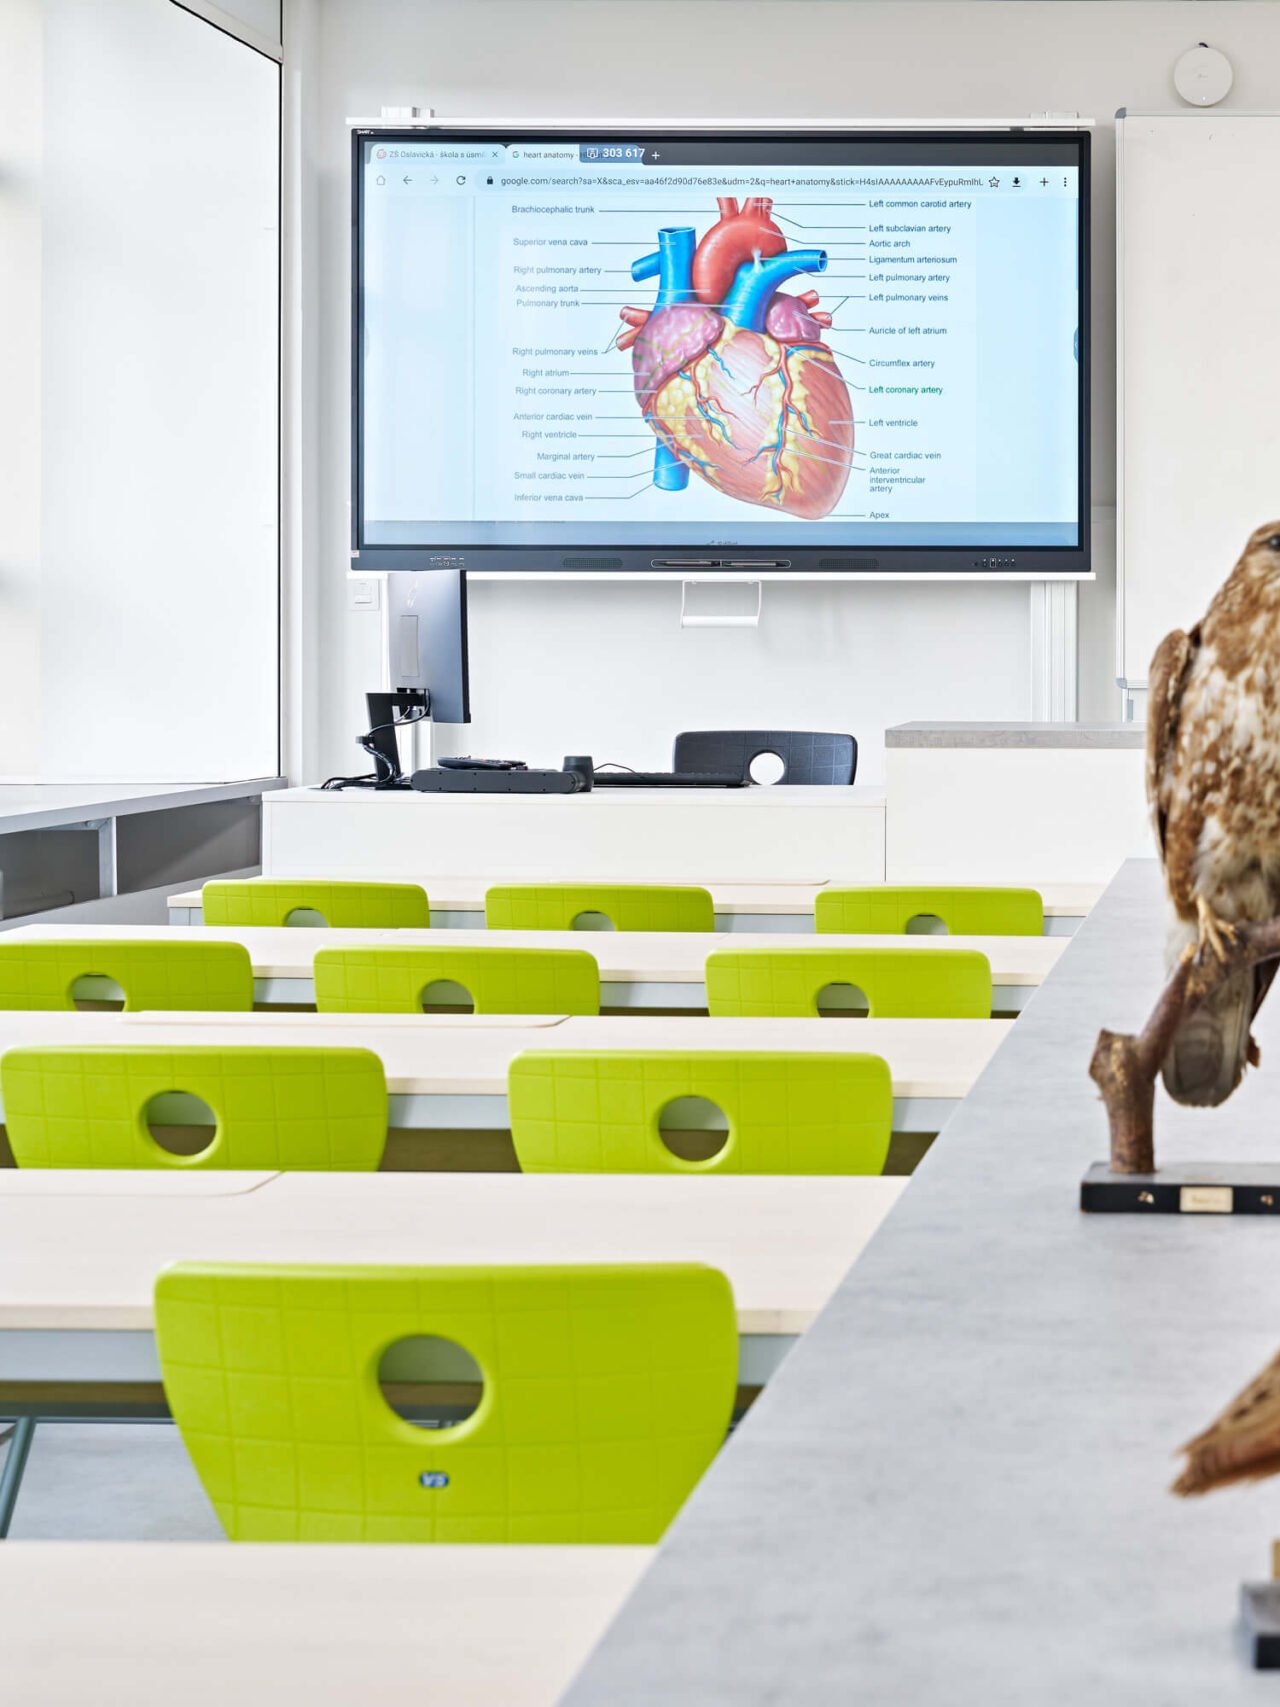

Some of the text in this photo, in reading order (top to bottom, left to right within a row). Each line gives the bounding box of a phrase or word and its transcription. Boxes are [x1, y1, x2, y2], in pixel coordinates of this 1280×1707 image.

[543, 152, 574, 160] anatomy
[603, 148, 646, 158] 303 617
[512, 205, 595, 215] Brachiocephalic trunk
[869, 200, 884, 208] Left
[920, 200, 947, 208] carotid
[949, 200, 972, 210] artery
[869, 224, 884, 232] Left
[928, 225, 951, 234] artery
[513, 238, 546, 247] Superior
[869, 240, 910, 248] Aortic arch
[869, 256, 957, 265] Ligamentum arteriosum
[514, 266, 602, 276] Right pulmonary artery
[869, 273, 950, 283] Left pulmonary artery
[515, 284, 579, 294] Ascending aorta
[869, 293, 884, 301] Left
[885, 293, 926, 303] pulmonary
[516, 299, 580, 309] Pulmonary trunk
[898, 326, 906, 334] of
[908, 326, 920, 335] left
[512, 347, 598, 357] Right pulmonary veins
[869, 359, 935, 369] Circumflex artery
[522, 368, 571, 378] Right atrium
[515, 386, 597, 396] Right coronary artery
[869, 386, 943, 396] Left coronary artery
[513, 412, 544, 420] Anterior
[546, 413, 575, 421] cardiac
[869, 418, 918, 427] Left ventricle
[522, 430, 578, 440] Right ventricle
[537, 452, 595, 462] Marginal artery
[870, 451, 892, 459] Great
[924, 452, 942, 460] vein
[869, 466, 900, 475] Anterior
[514, 472, 585, 480] Small cardiac vein
[870, 476, 926, 484] interventricular
[869, 485, 893, 494] artery
[514, 493, 542, 501] Inferior
[869, 511, 890, 520] Apex
